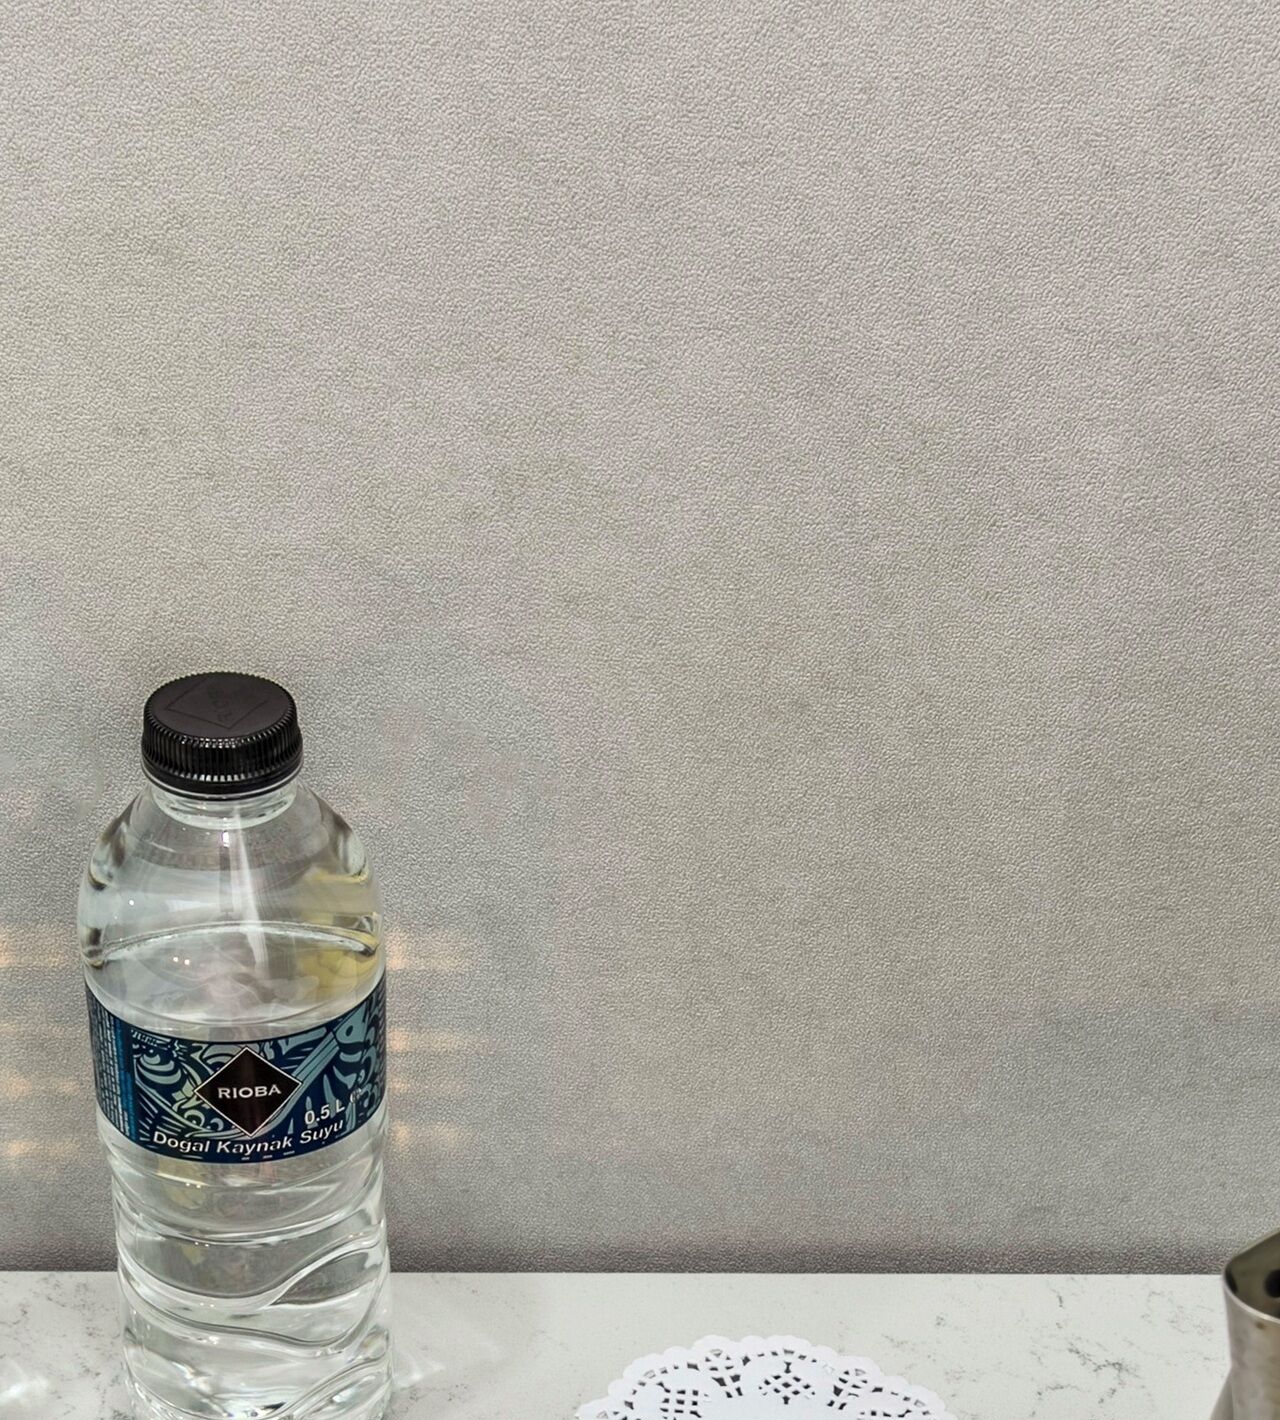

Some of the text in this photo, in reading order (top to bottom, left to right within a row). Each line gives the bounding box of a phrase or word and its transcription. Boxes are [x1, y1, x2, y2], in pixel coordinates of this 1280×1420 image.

[217, 1083, 283, 1100] RIOBA
[304, 1099, 346, 1125] 0.5 L
[216, 1136, 293, 1156] Kaynak
[300, 1119, 344, 1144] Suyu
